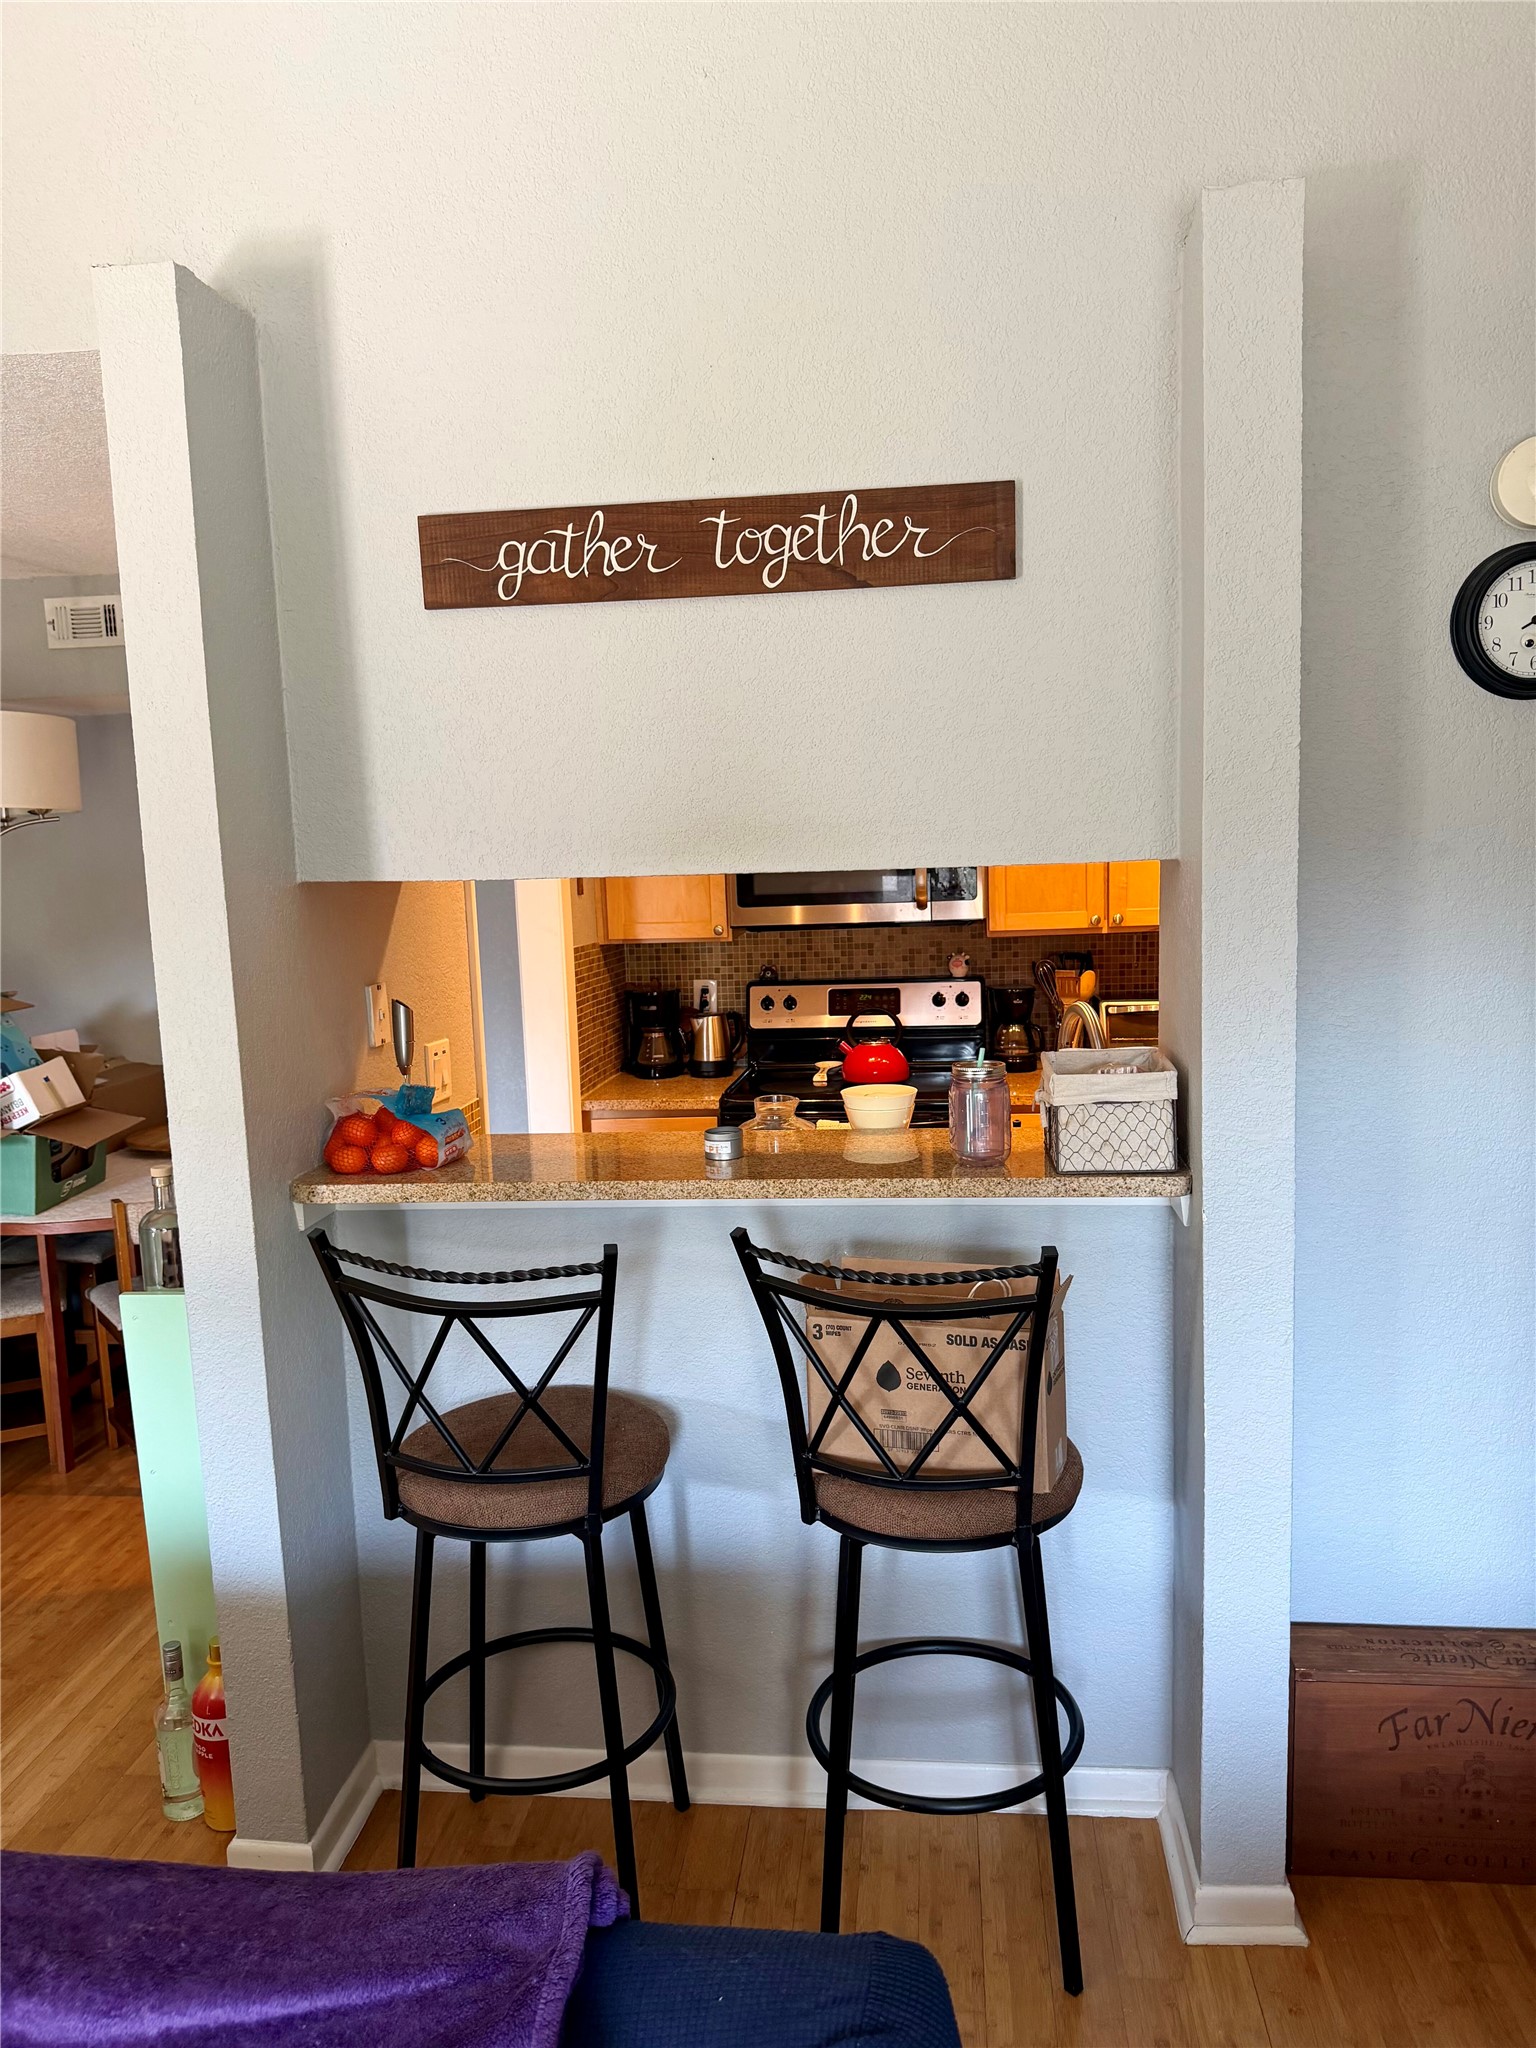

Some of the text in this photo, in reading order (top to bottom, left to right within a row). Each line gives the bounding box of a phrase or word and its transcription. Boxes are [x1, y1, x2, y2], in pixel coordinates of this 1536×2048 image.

[440, 494, 995, 600] gather together
[1508, 576, 1523, 591] 11
[1492, 593, 1508, 608] 10
[1484, 615, 1494, 630] 9
[1492, 637, 1501, 652] 8
[1508, 652, 1518, 667] 7
[812, 1324, 824, 1340] 3
[946, 1334, 978, 1347] SOLD
[981, 1336, 999, 1349] AS
[1006, 1339, 1029, 1351] AS
[905, 1367, 966, 1385] Sevnth
[1400, 1651, 1499, 1670] Niente
[1378, 1708, 1450, 1751] Far
